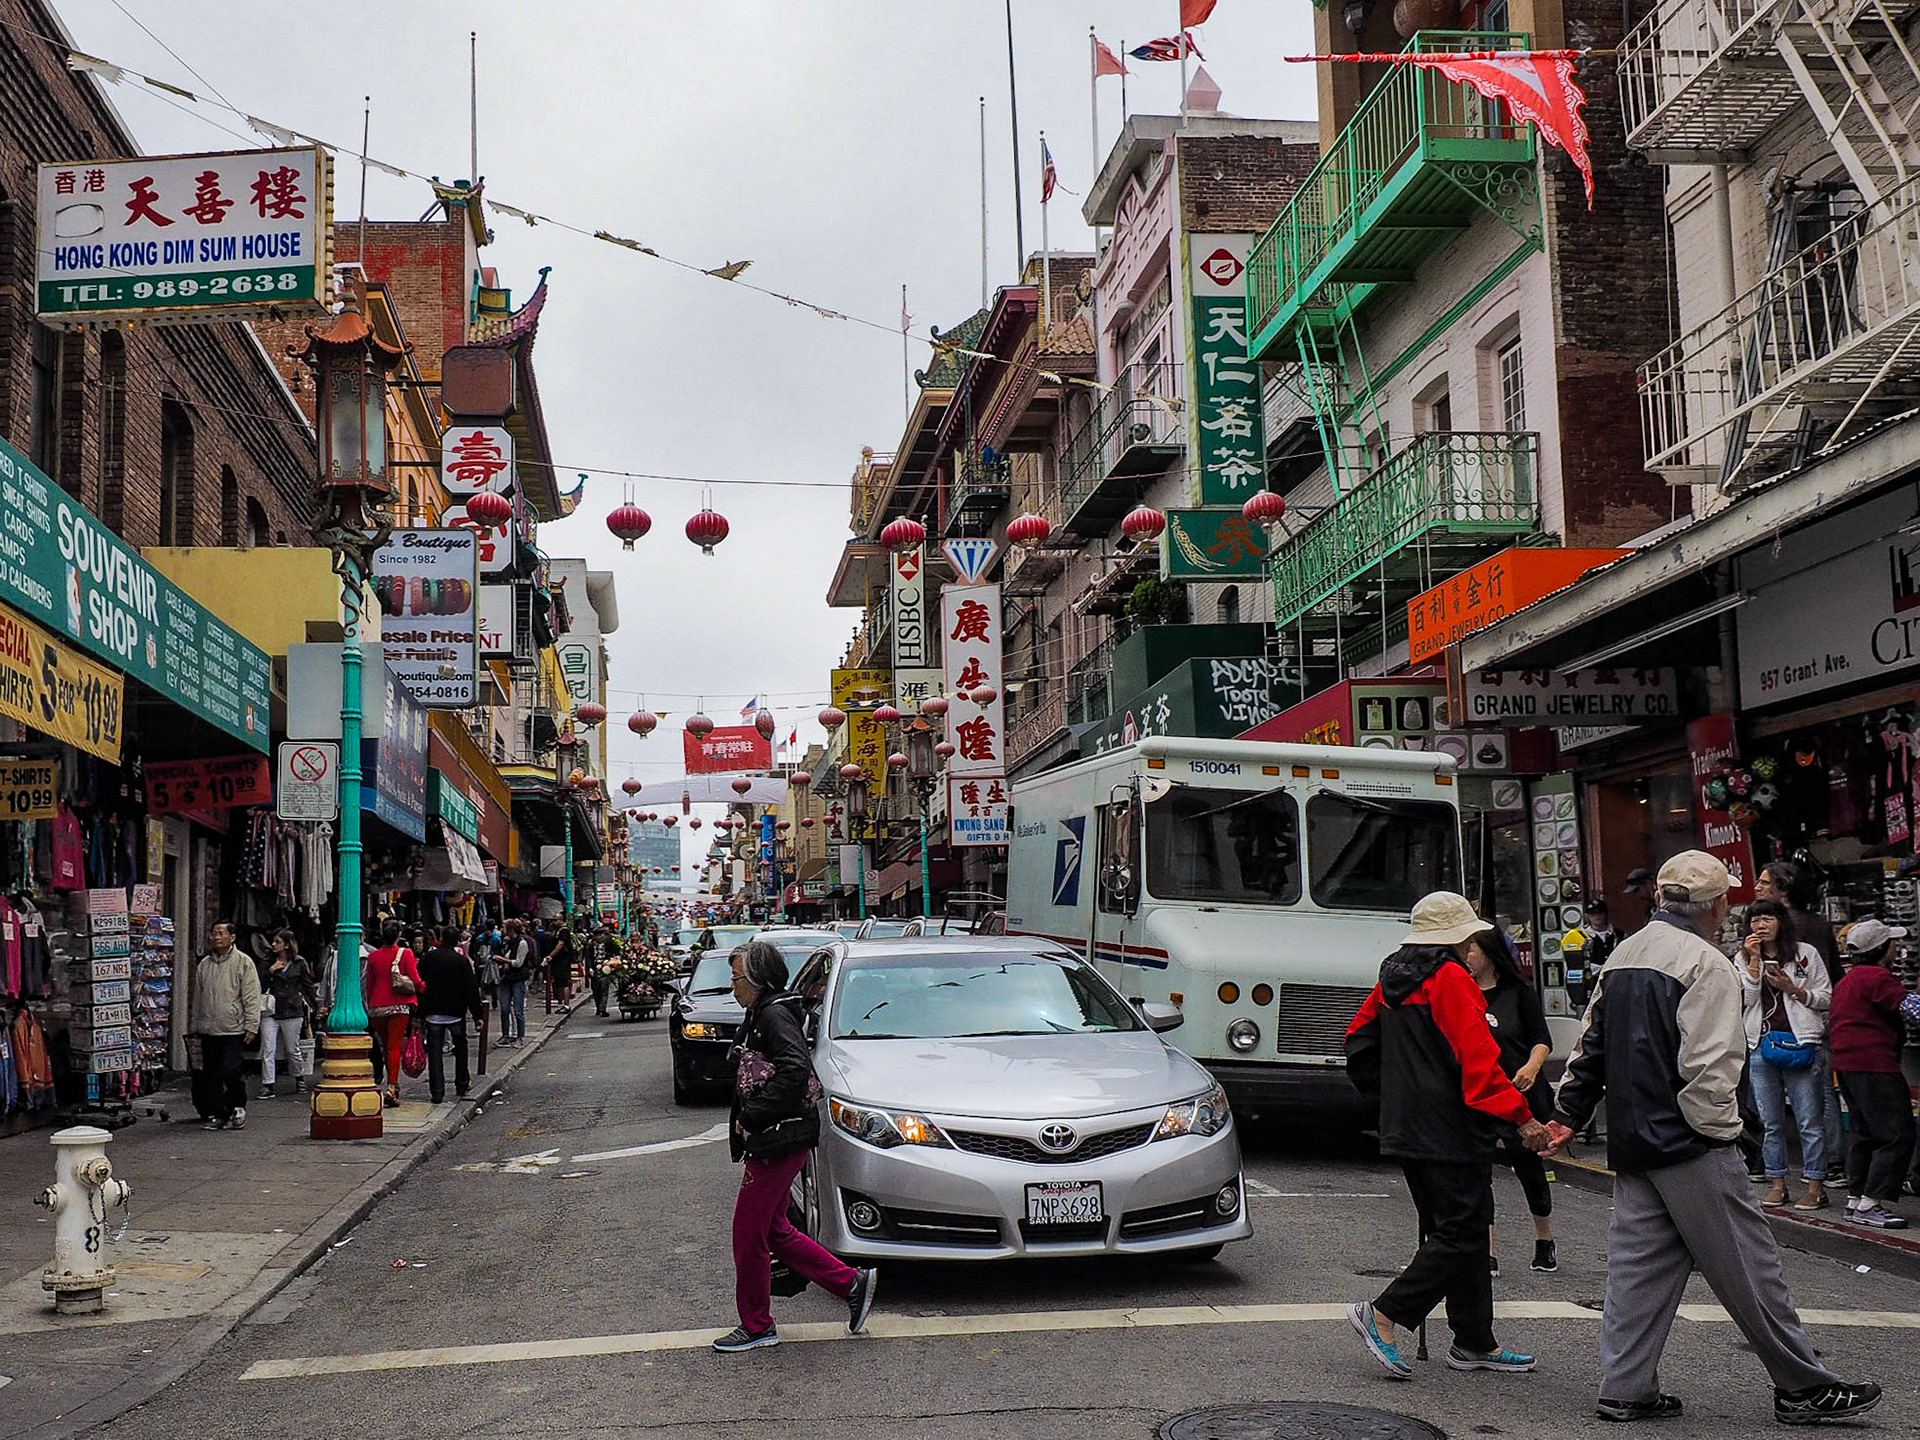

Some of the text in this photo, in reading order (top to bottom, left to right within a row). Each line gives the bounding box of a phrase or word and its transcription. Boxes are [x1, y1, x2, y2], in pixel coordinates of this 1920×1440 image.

[54, 169, 106, 195] 香港
[123, 165, 307, 228] 天喜樓
[55, 232, 301, 271] HONG KONG DIM SUM HOUSE
[58, 273, 298, 304] TEL: 989-2638
[4, 509, 36, 547] CARDS
[402, 533, 472, 553] Boutique
[57, 501, 161, 628] SOUVENIR
[379, 555, 437, 564] Since 1982
[88, 588, 139, 662] SHOP
[431, 630, 474, 643] Price
[898, 587, 922, 662] HSBC
[1414, 632, 1446, 658] GRAND
[1448, 611, 1486, 643] JEWELRY
[405, 647, 458, 661] Publc
[41, 643, 58, 722] 5
[59, 678, 75, 715] FOR
[166, 670, 179, 689] KEY
[950, 599, 997, 762] 廣生隆
[1760, 653, 1850, 691] 957 Grant Ave.
[1474, 693, 1674, 715] GRAND JEWELRY CO.
[0, 768, 52, 786] T-SHIRTS
[1188, 761, 1241, 776] 1510041
[154, 783, 169, 807] 5
[954, 818, 981, 831] KWONG
[984, 818, 1004, 831] SANG
[967, 833, 991, 841] GIFTS
[1047, 1181, 1082, 1189] TOYOTA
[1031, 1196, 1099, 1217] 7NPS698
[1029, 1215, 1103, 1225] SAN FRANCISCO
[85, 1226, 100, 1253] 8
